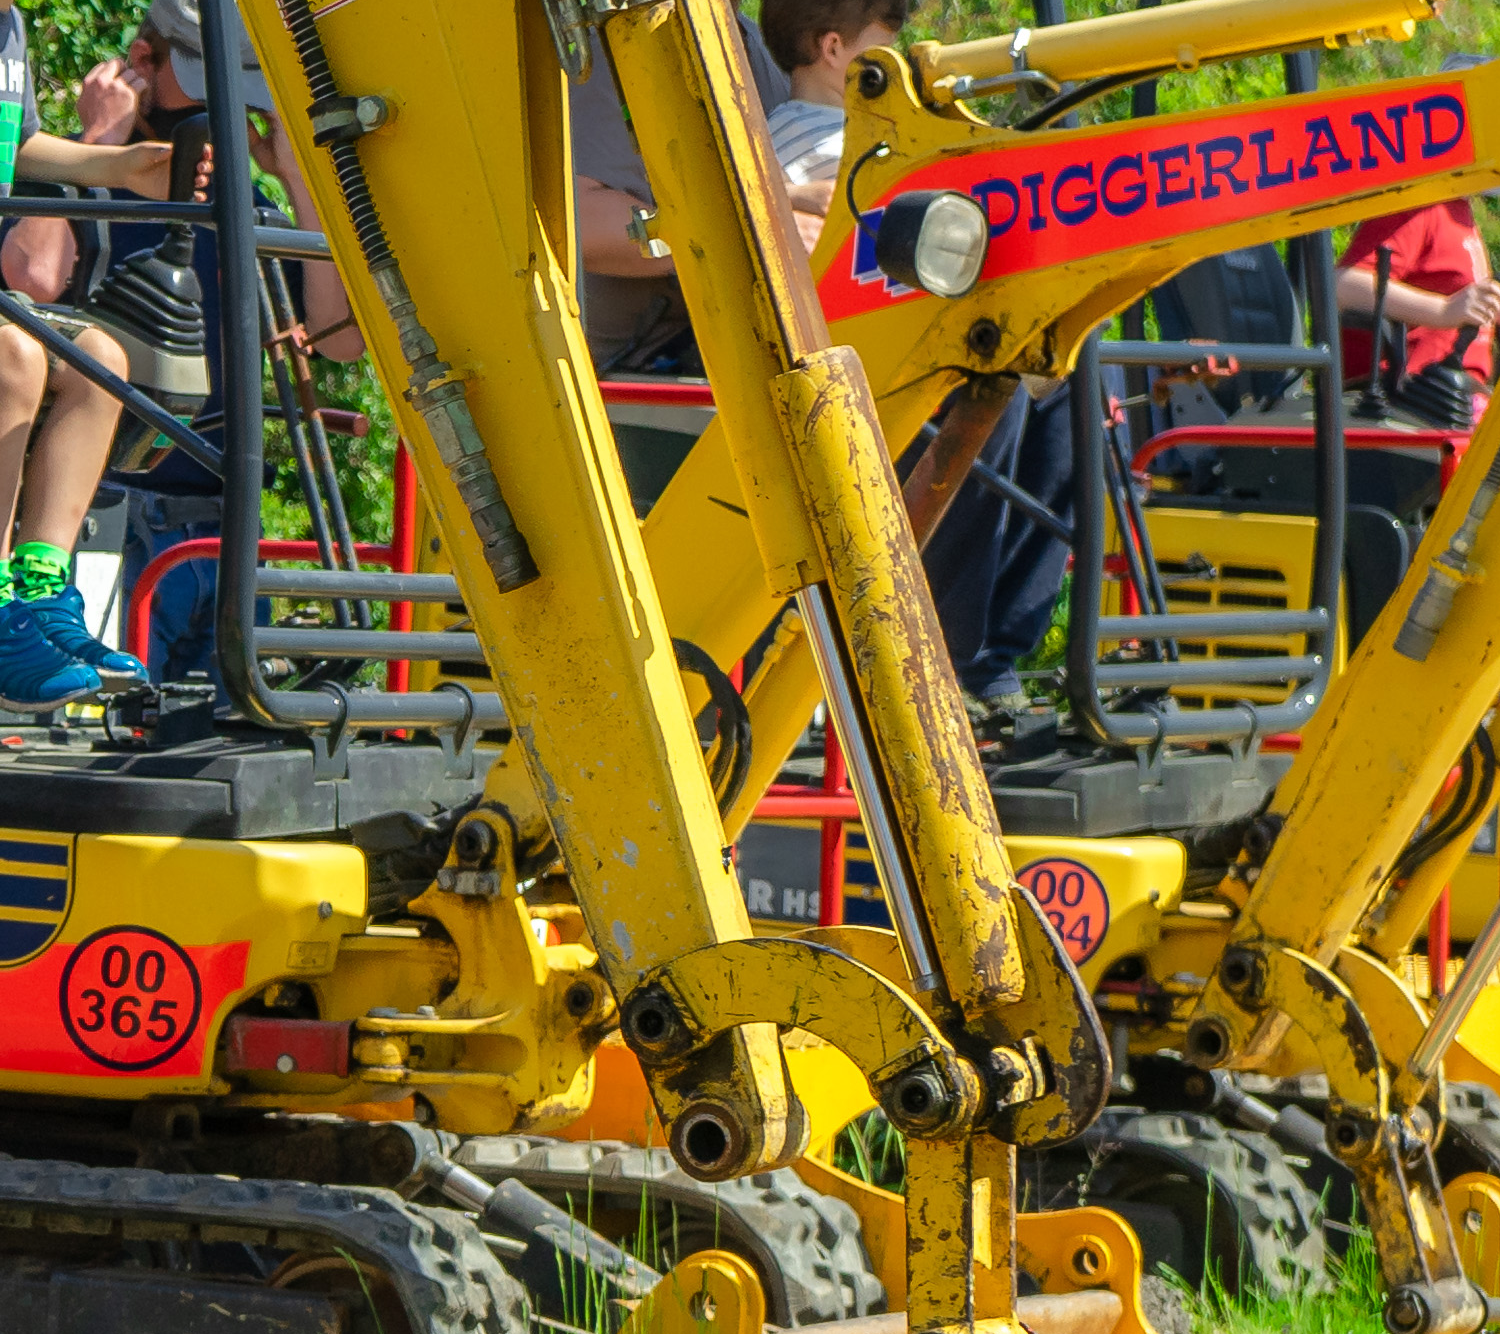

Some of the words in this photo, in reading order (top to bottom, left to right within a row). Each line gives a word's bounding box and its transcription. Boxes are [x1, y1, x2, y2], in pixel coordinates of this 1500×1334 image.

[970, 94, 1466, 239] DIGGERLAND
[1031, 869, 1085, 907] 00
[101, 945, 166, 993] 00
[77, 988, 178, 1043] 365
